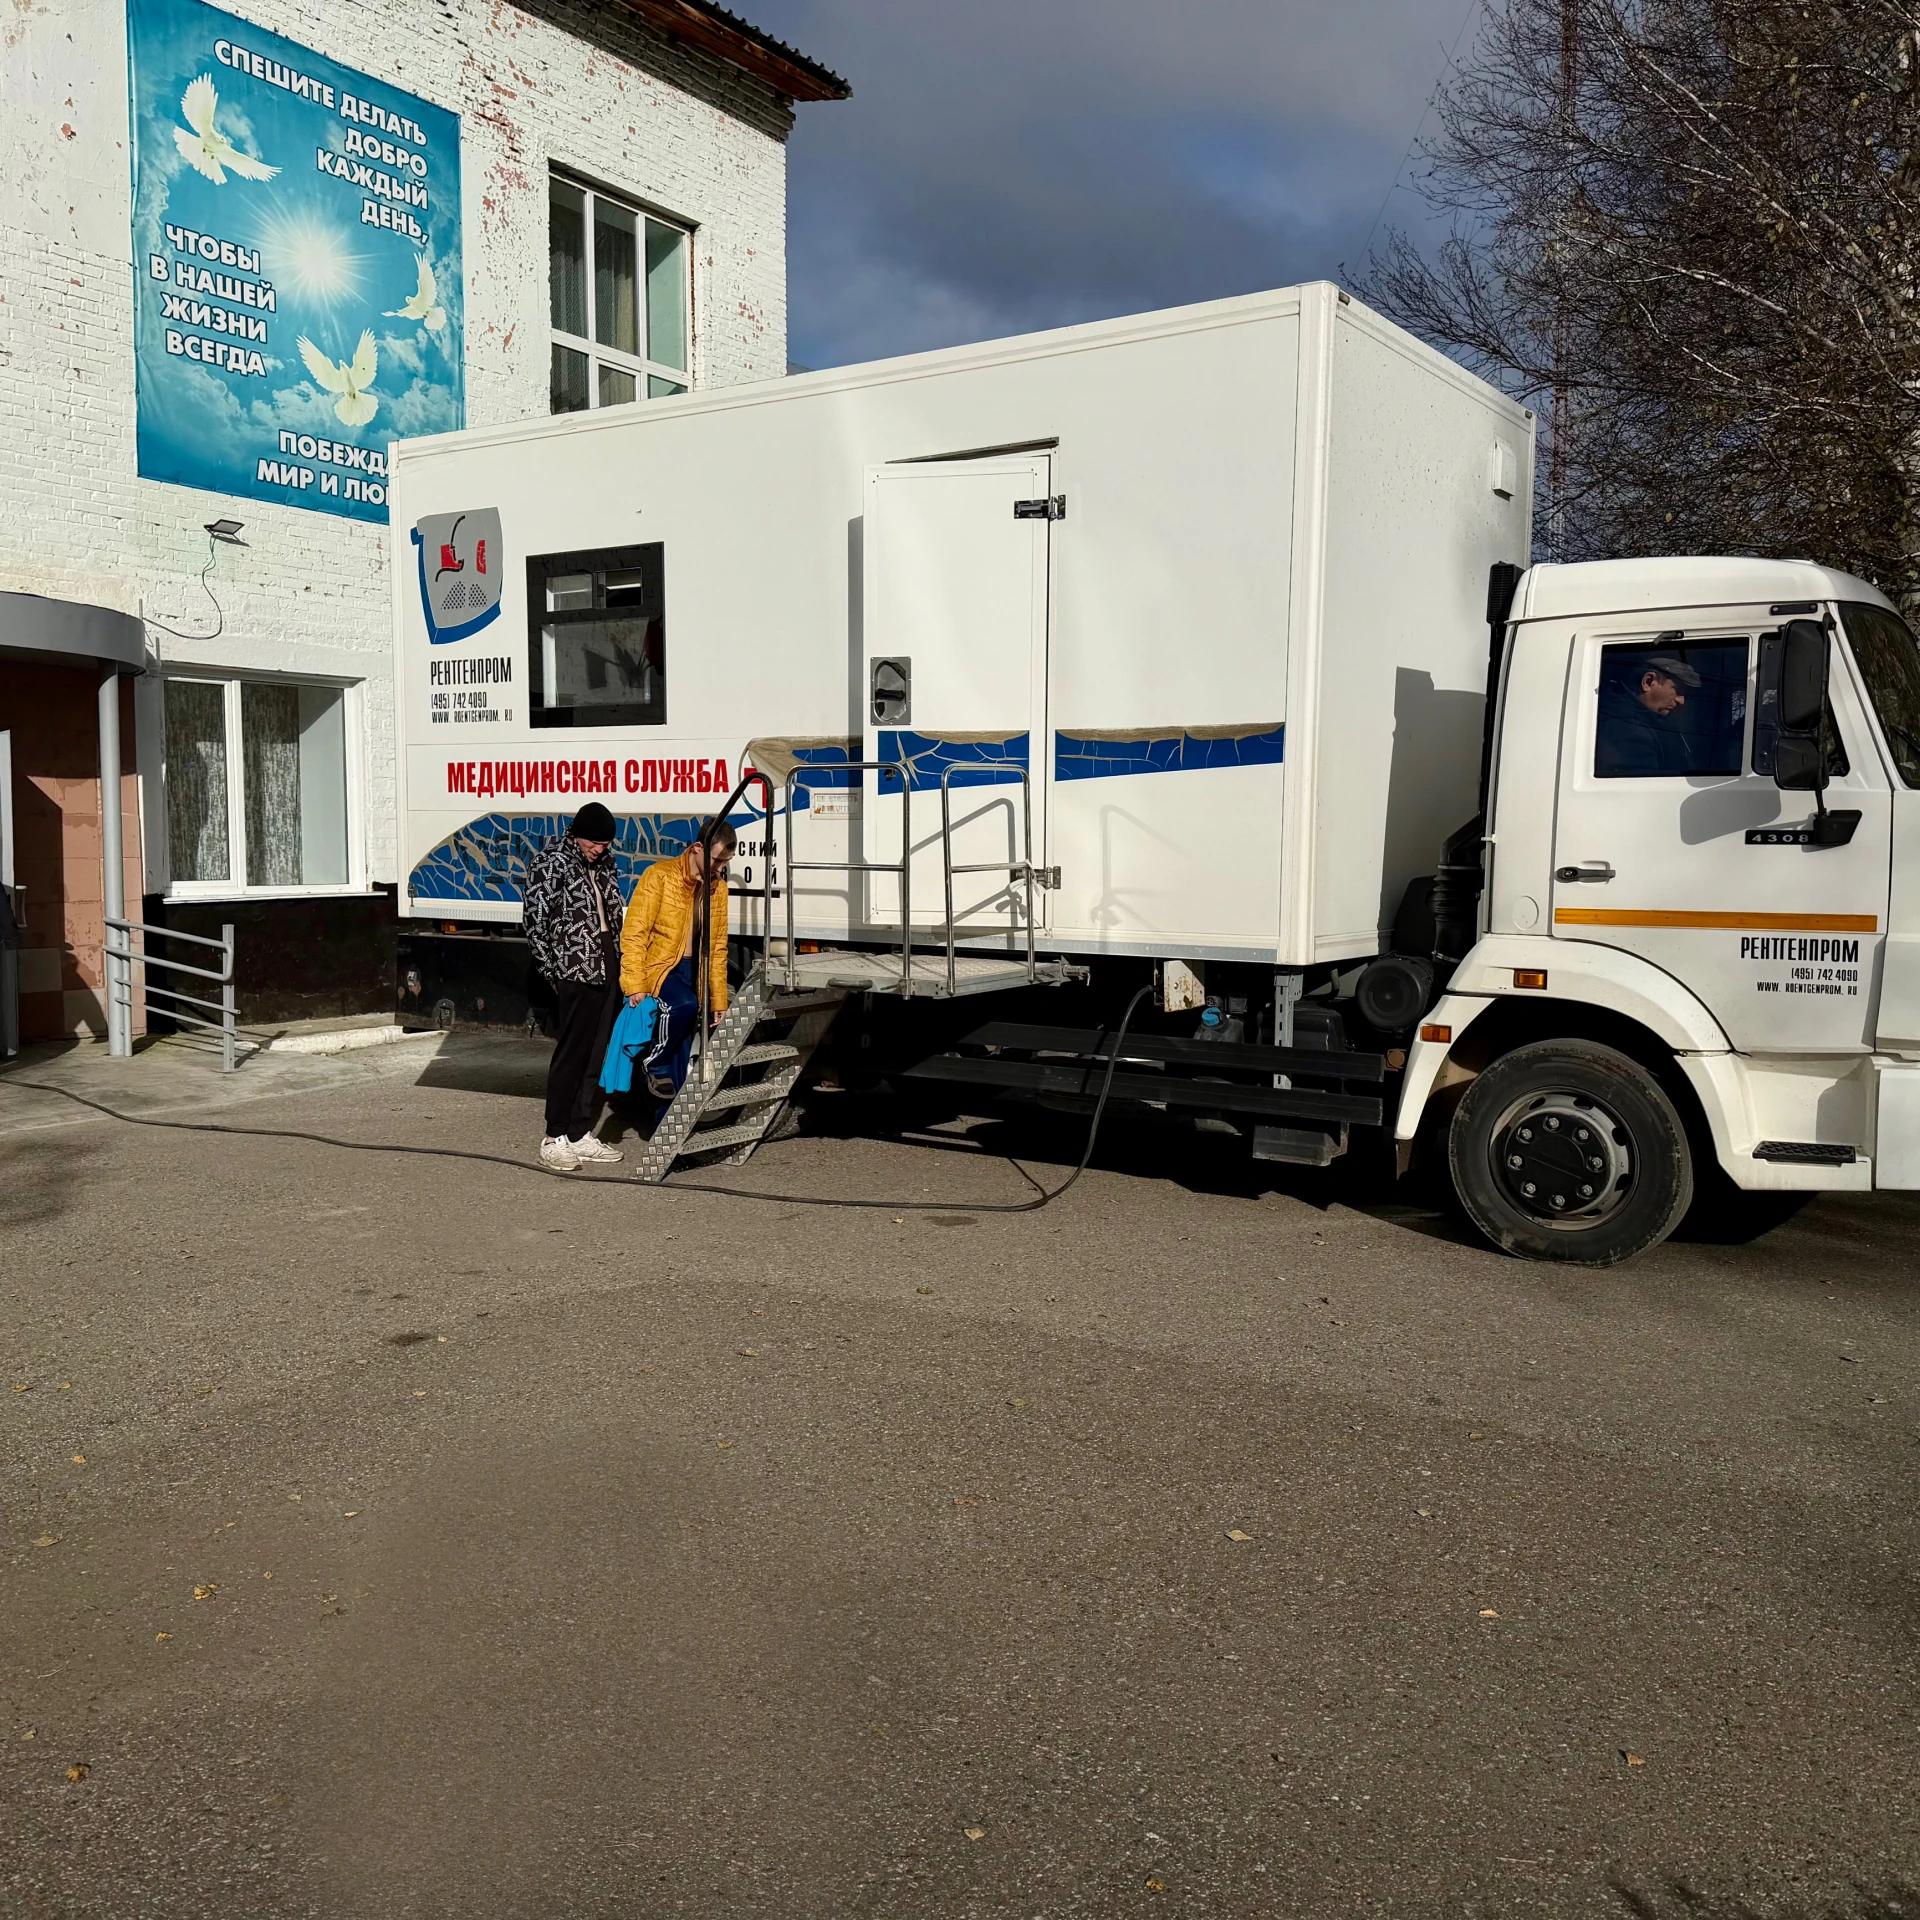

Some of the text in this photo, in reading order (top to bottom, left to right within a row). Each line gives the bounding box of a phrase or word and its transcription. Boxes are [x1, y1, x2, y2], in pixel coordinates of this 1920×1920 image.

[214, 39, 428, 146] СПЕШИТЕ ДЕЛАТЬ
[344, 128, 428, 178] ДОБРО
[316, 148, 428, 210] КАЖДЫЙ
[361, 199, 429, 243] ДЕНЬ,
[165, 224, 260, 274] ЧТОБЫ
[150, 254, 276, 312] В НАШЕЙ
[161, 292, 267, 343] ЖИЗНИ
[166, 330, 267, 377] ВСЕГДА
[278, 430, 389, 478] ПОБЕЖД
[257, 460, 314, 489] МИР
[320, 472, 339, 496] И
[431, 657, 512, 685] РЕНТГЕНПРОМ
[431, 691, 487, 709] (495) 742 4090
[447, 759, 729, 799] МЕДИЦИНСКАЯ СЛУЖБА
[1752, 834, 1809, 843] 4308
[1741, 937, 1859, 962] РЕНТГЕНПРОМ
[1791, 967, 1858, 982] (495) 742 4090
